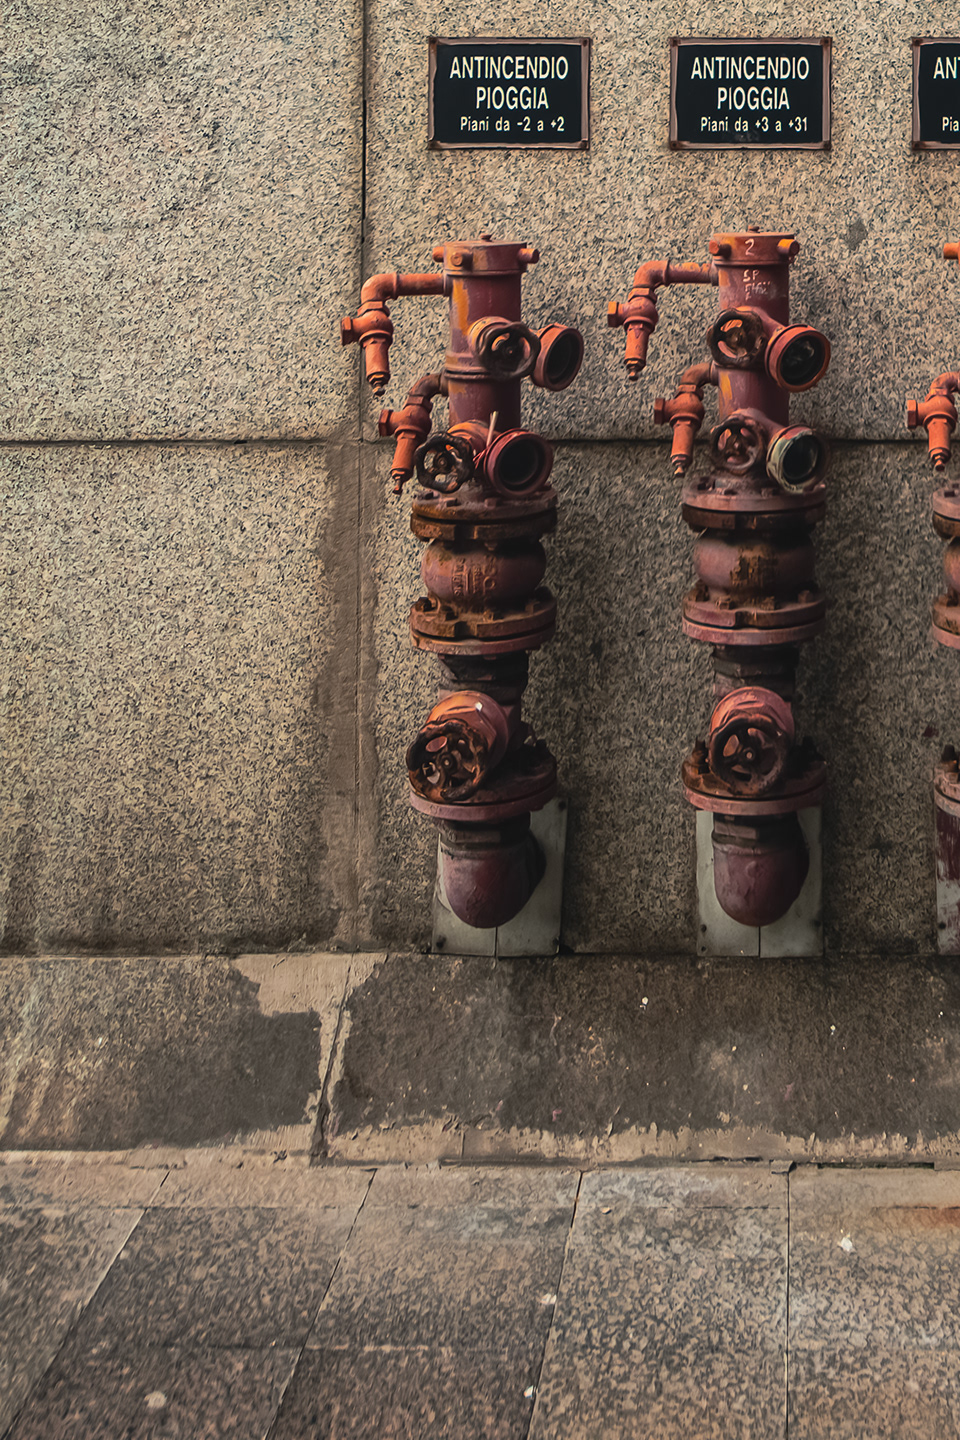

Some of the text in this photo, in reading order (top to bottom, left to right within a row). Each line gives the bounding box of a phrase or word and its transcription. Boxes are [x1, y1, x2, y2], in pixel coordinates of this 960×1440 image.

[449, 55, 569, 80] ANTINCENDIO
[690, 55, 810, 81] ANTINCENDIO
[475, 85, 550, 110] PIOGGIA
[717, 86, 790, 111] PIOGGIA
[460, 115, 565, 132] Piani da -2 a +2
[700, 116, 808, 132] Piani da +3 a +31
[744, 238, 755, 256] 2
